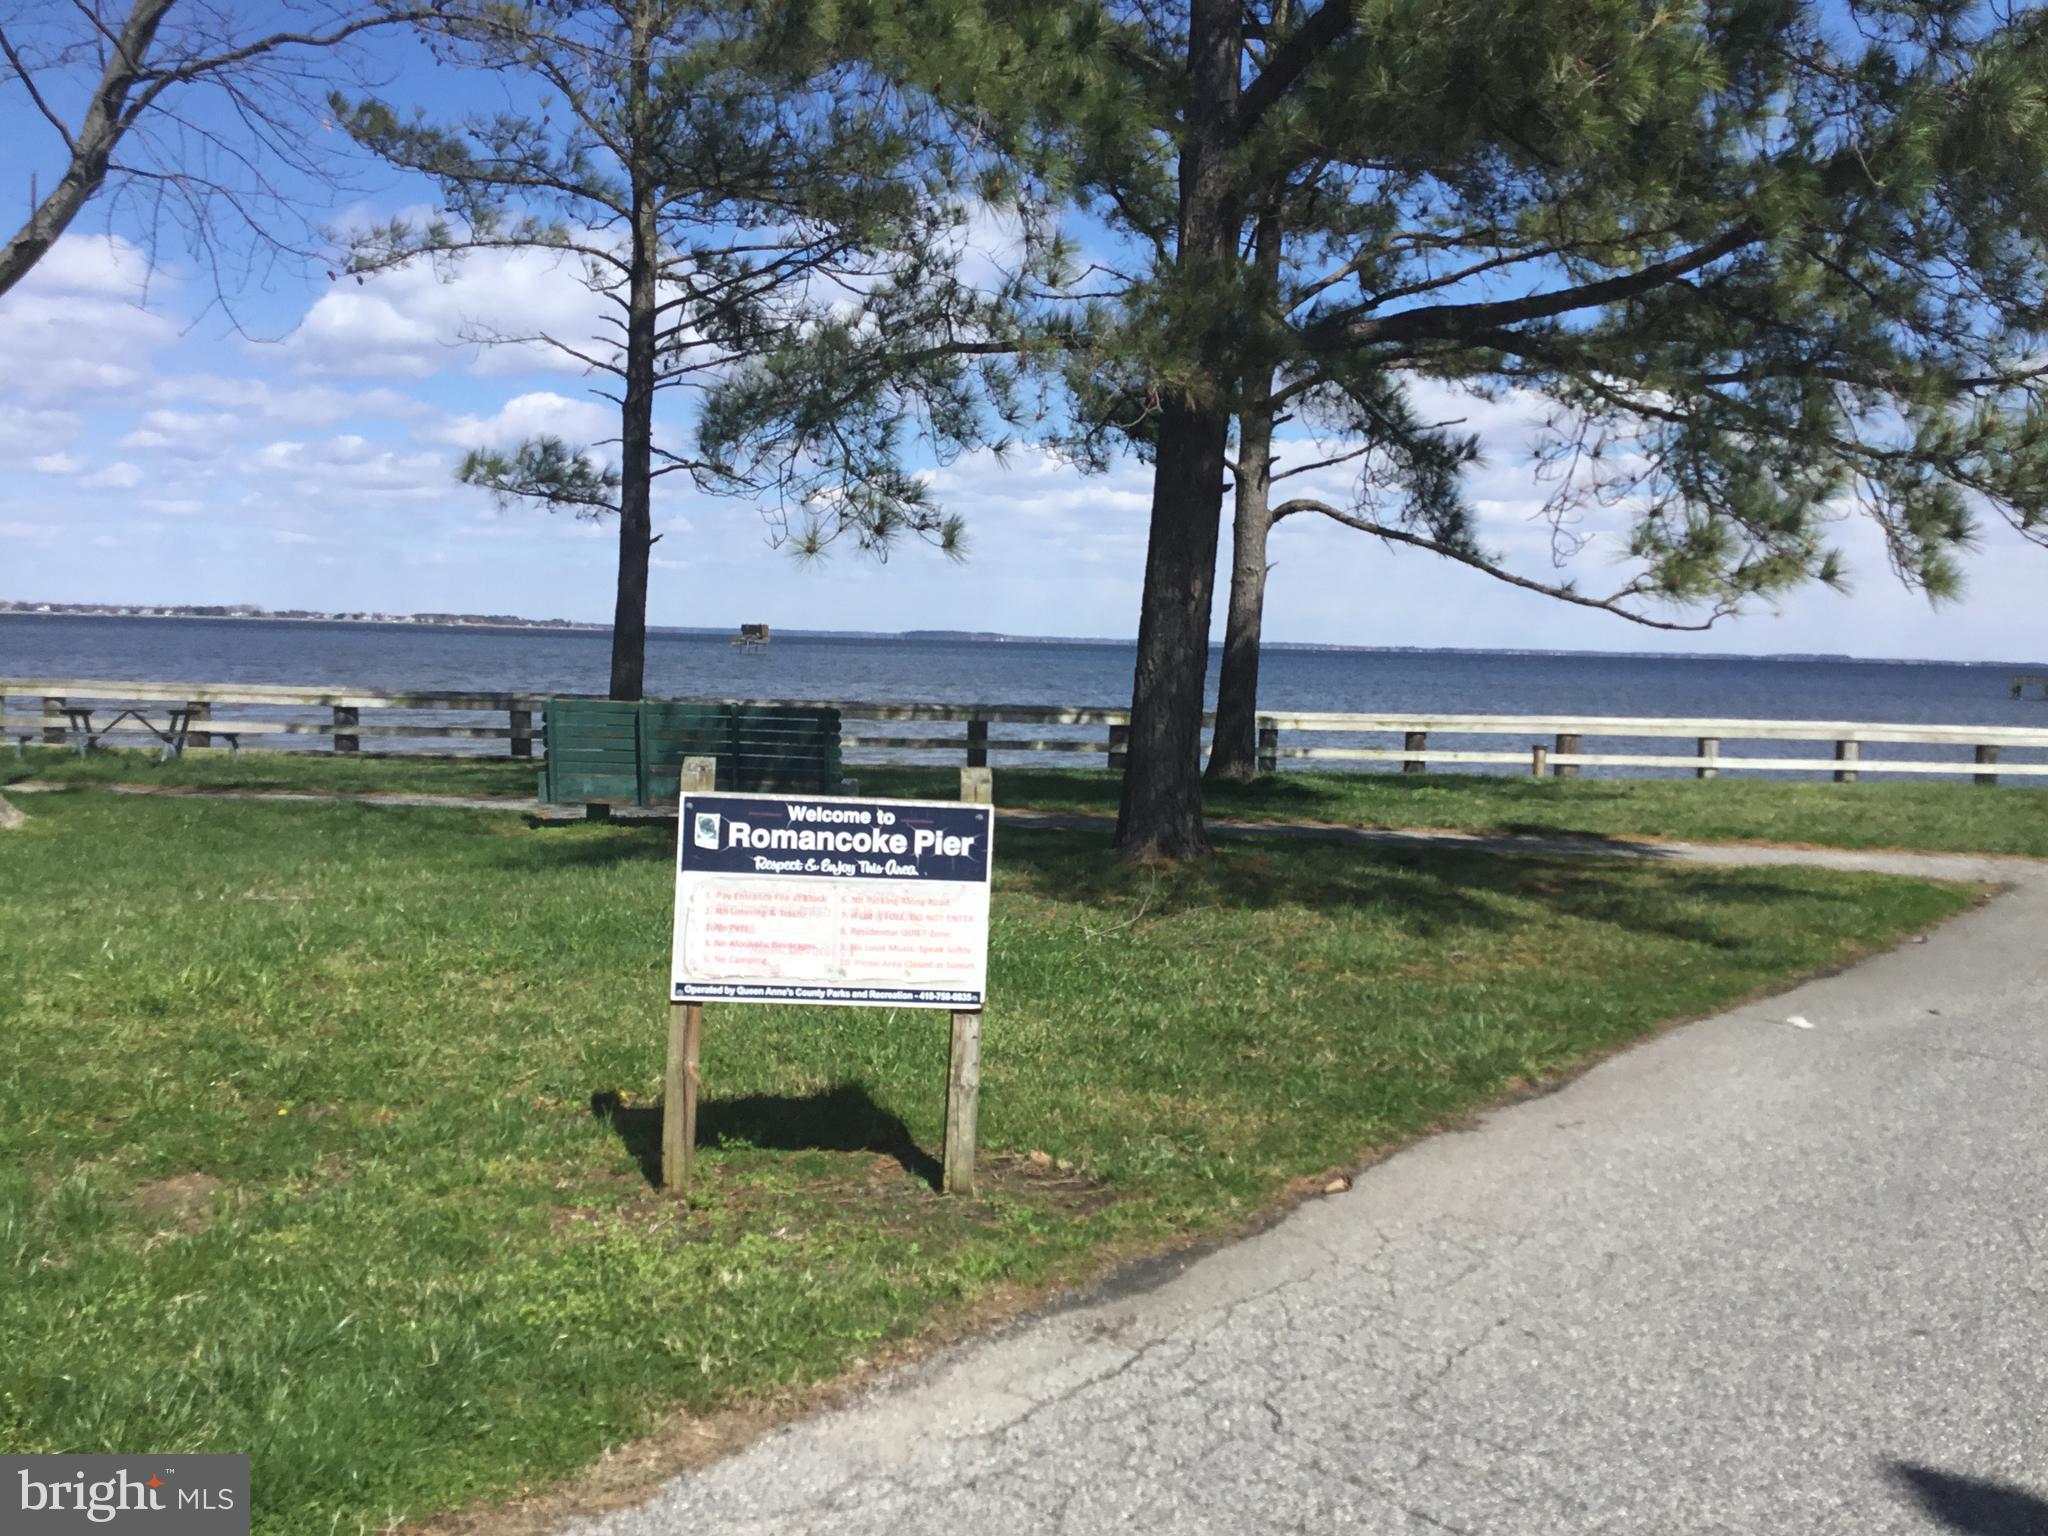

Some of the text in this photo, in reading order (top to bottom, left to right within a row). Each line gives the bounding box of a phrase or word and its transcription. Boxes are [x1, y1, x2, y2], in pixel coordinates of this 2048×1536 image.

[788, 804, 896, 825] Welcome to
[729, 821, 974, 857] Romancoke Pier
[754, 856, 803, 873] Respect
[805, 858, 819, 871] &
[820, 858, 856, 876] Enjoy
[858, 860, 884, 874] This
[925, 914, 944, 922] NOT
[850, 928, 898, 937] Residential
[900, 929, 927, 937] QUIET
[904, 961, 934, 969] Closed
[684, 985, 723, 995] Operated
[725, 986, 735, 996] by
[736, 986, 764, 996] Queen
[765, 987, 794, 997] Anne's
[795, 988, 825, 999] County
[826, 989, 850, 998] Parks
[852, 990, 868, 998] and
[869, 990, 913, 1000] Recreation
